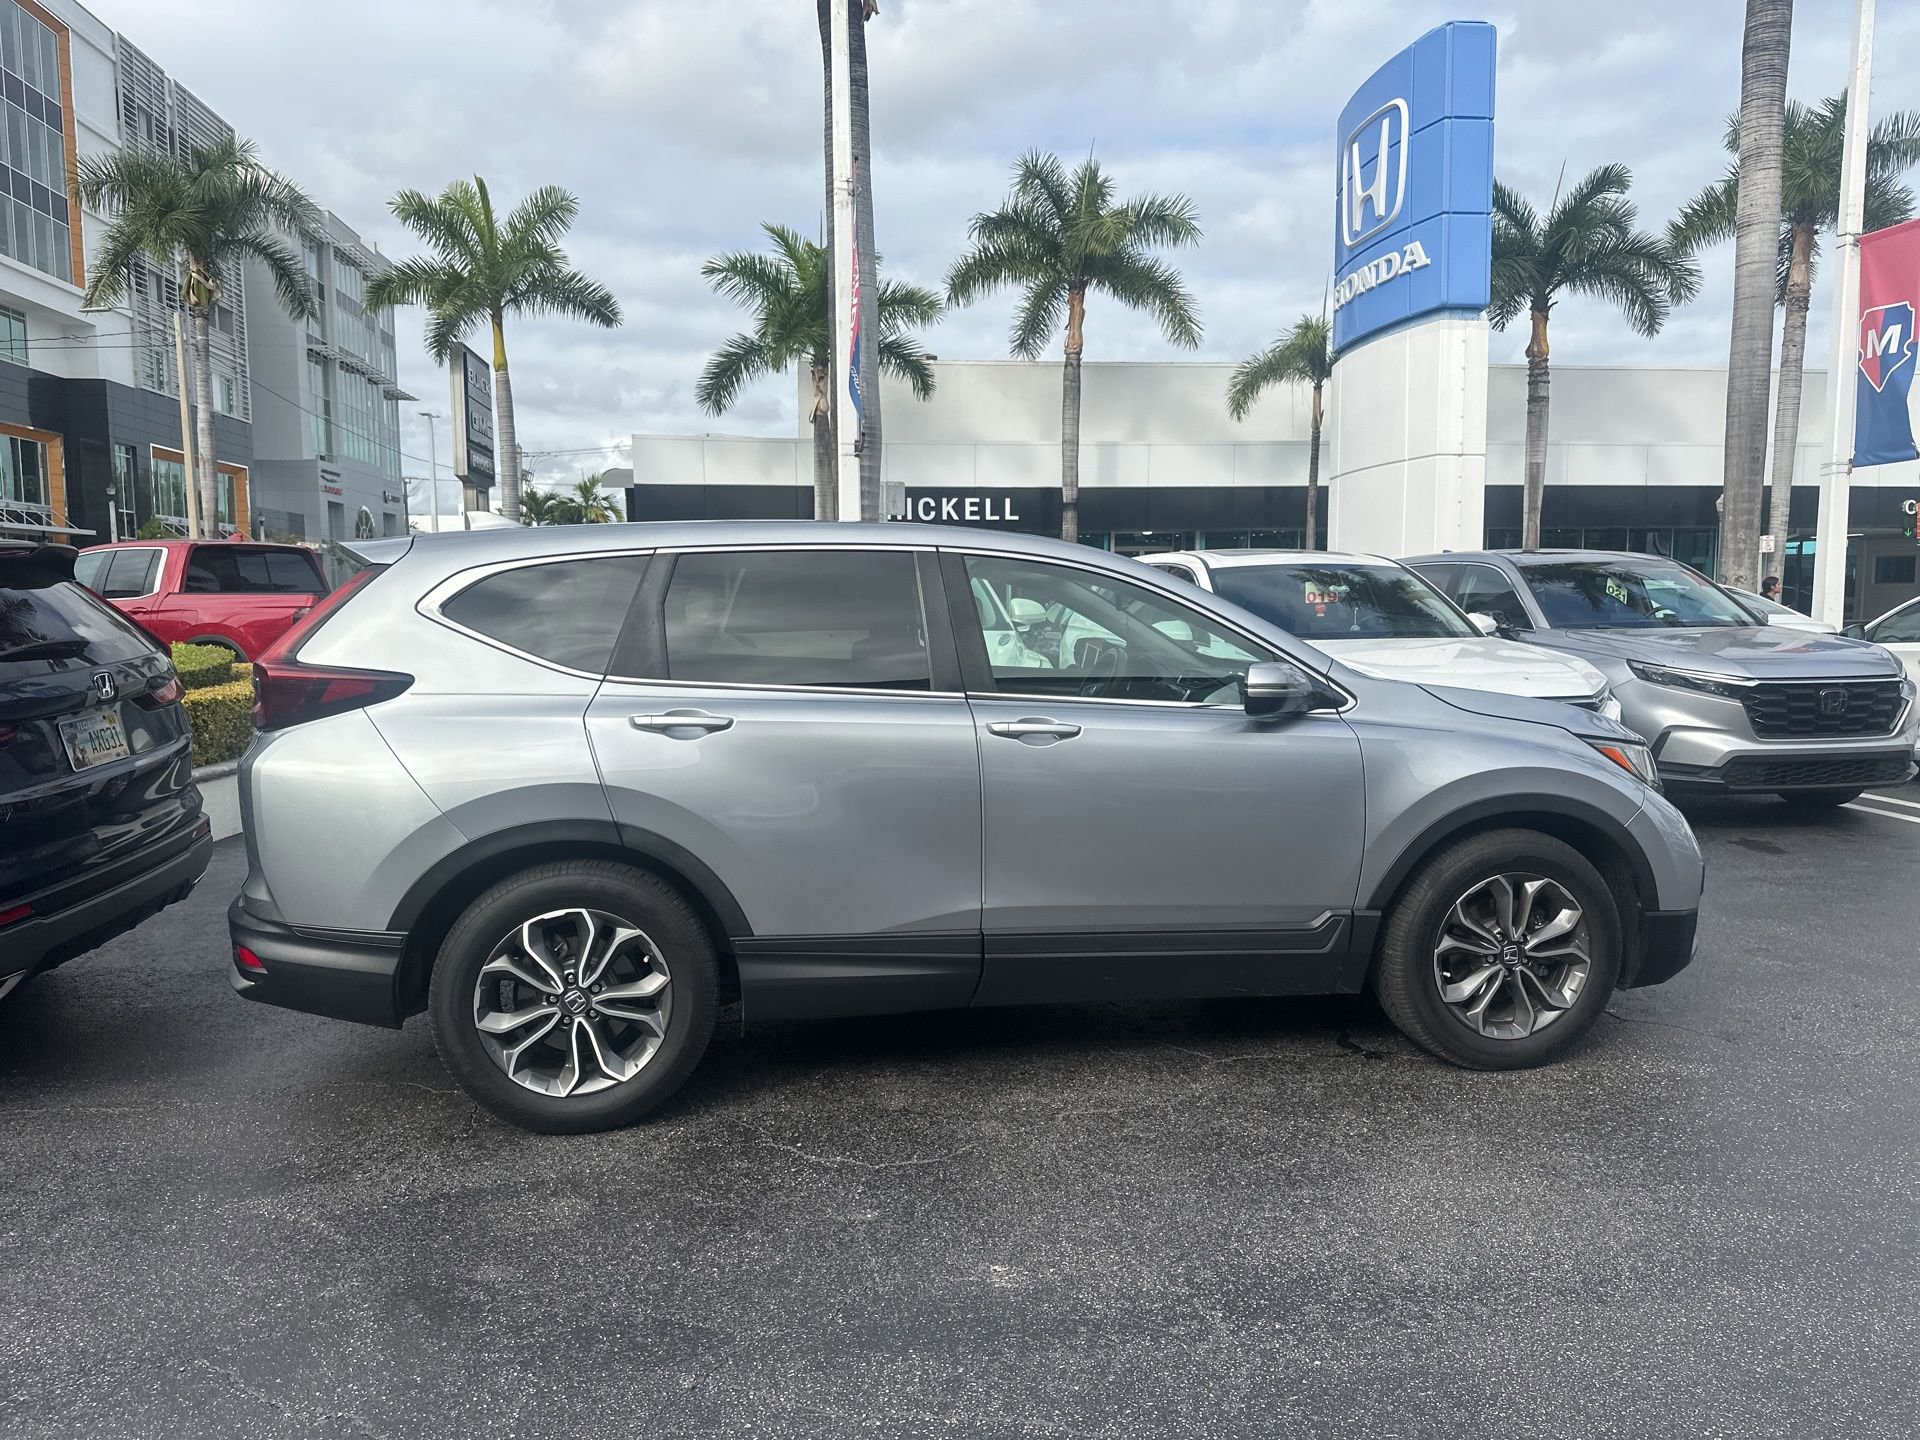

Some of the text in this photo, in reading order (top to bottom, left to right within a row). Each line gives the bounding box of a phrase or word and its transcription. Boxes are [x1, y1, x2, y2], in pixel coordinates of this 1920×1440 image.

[1334, 240, 1431, 311] HONDA
[1867, 323, 1902, 359] M
[888, 497, 1019, 521] ICKELL
[1307, 592, 1337, 603] 019
[1608, 586, 1626, 602] 021
